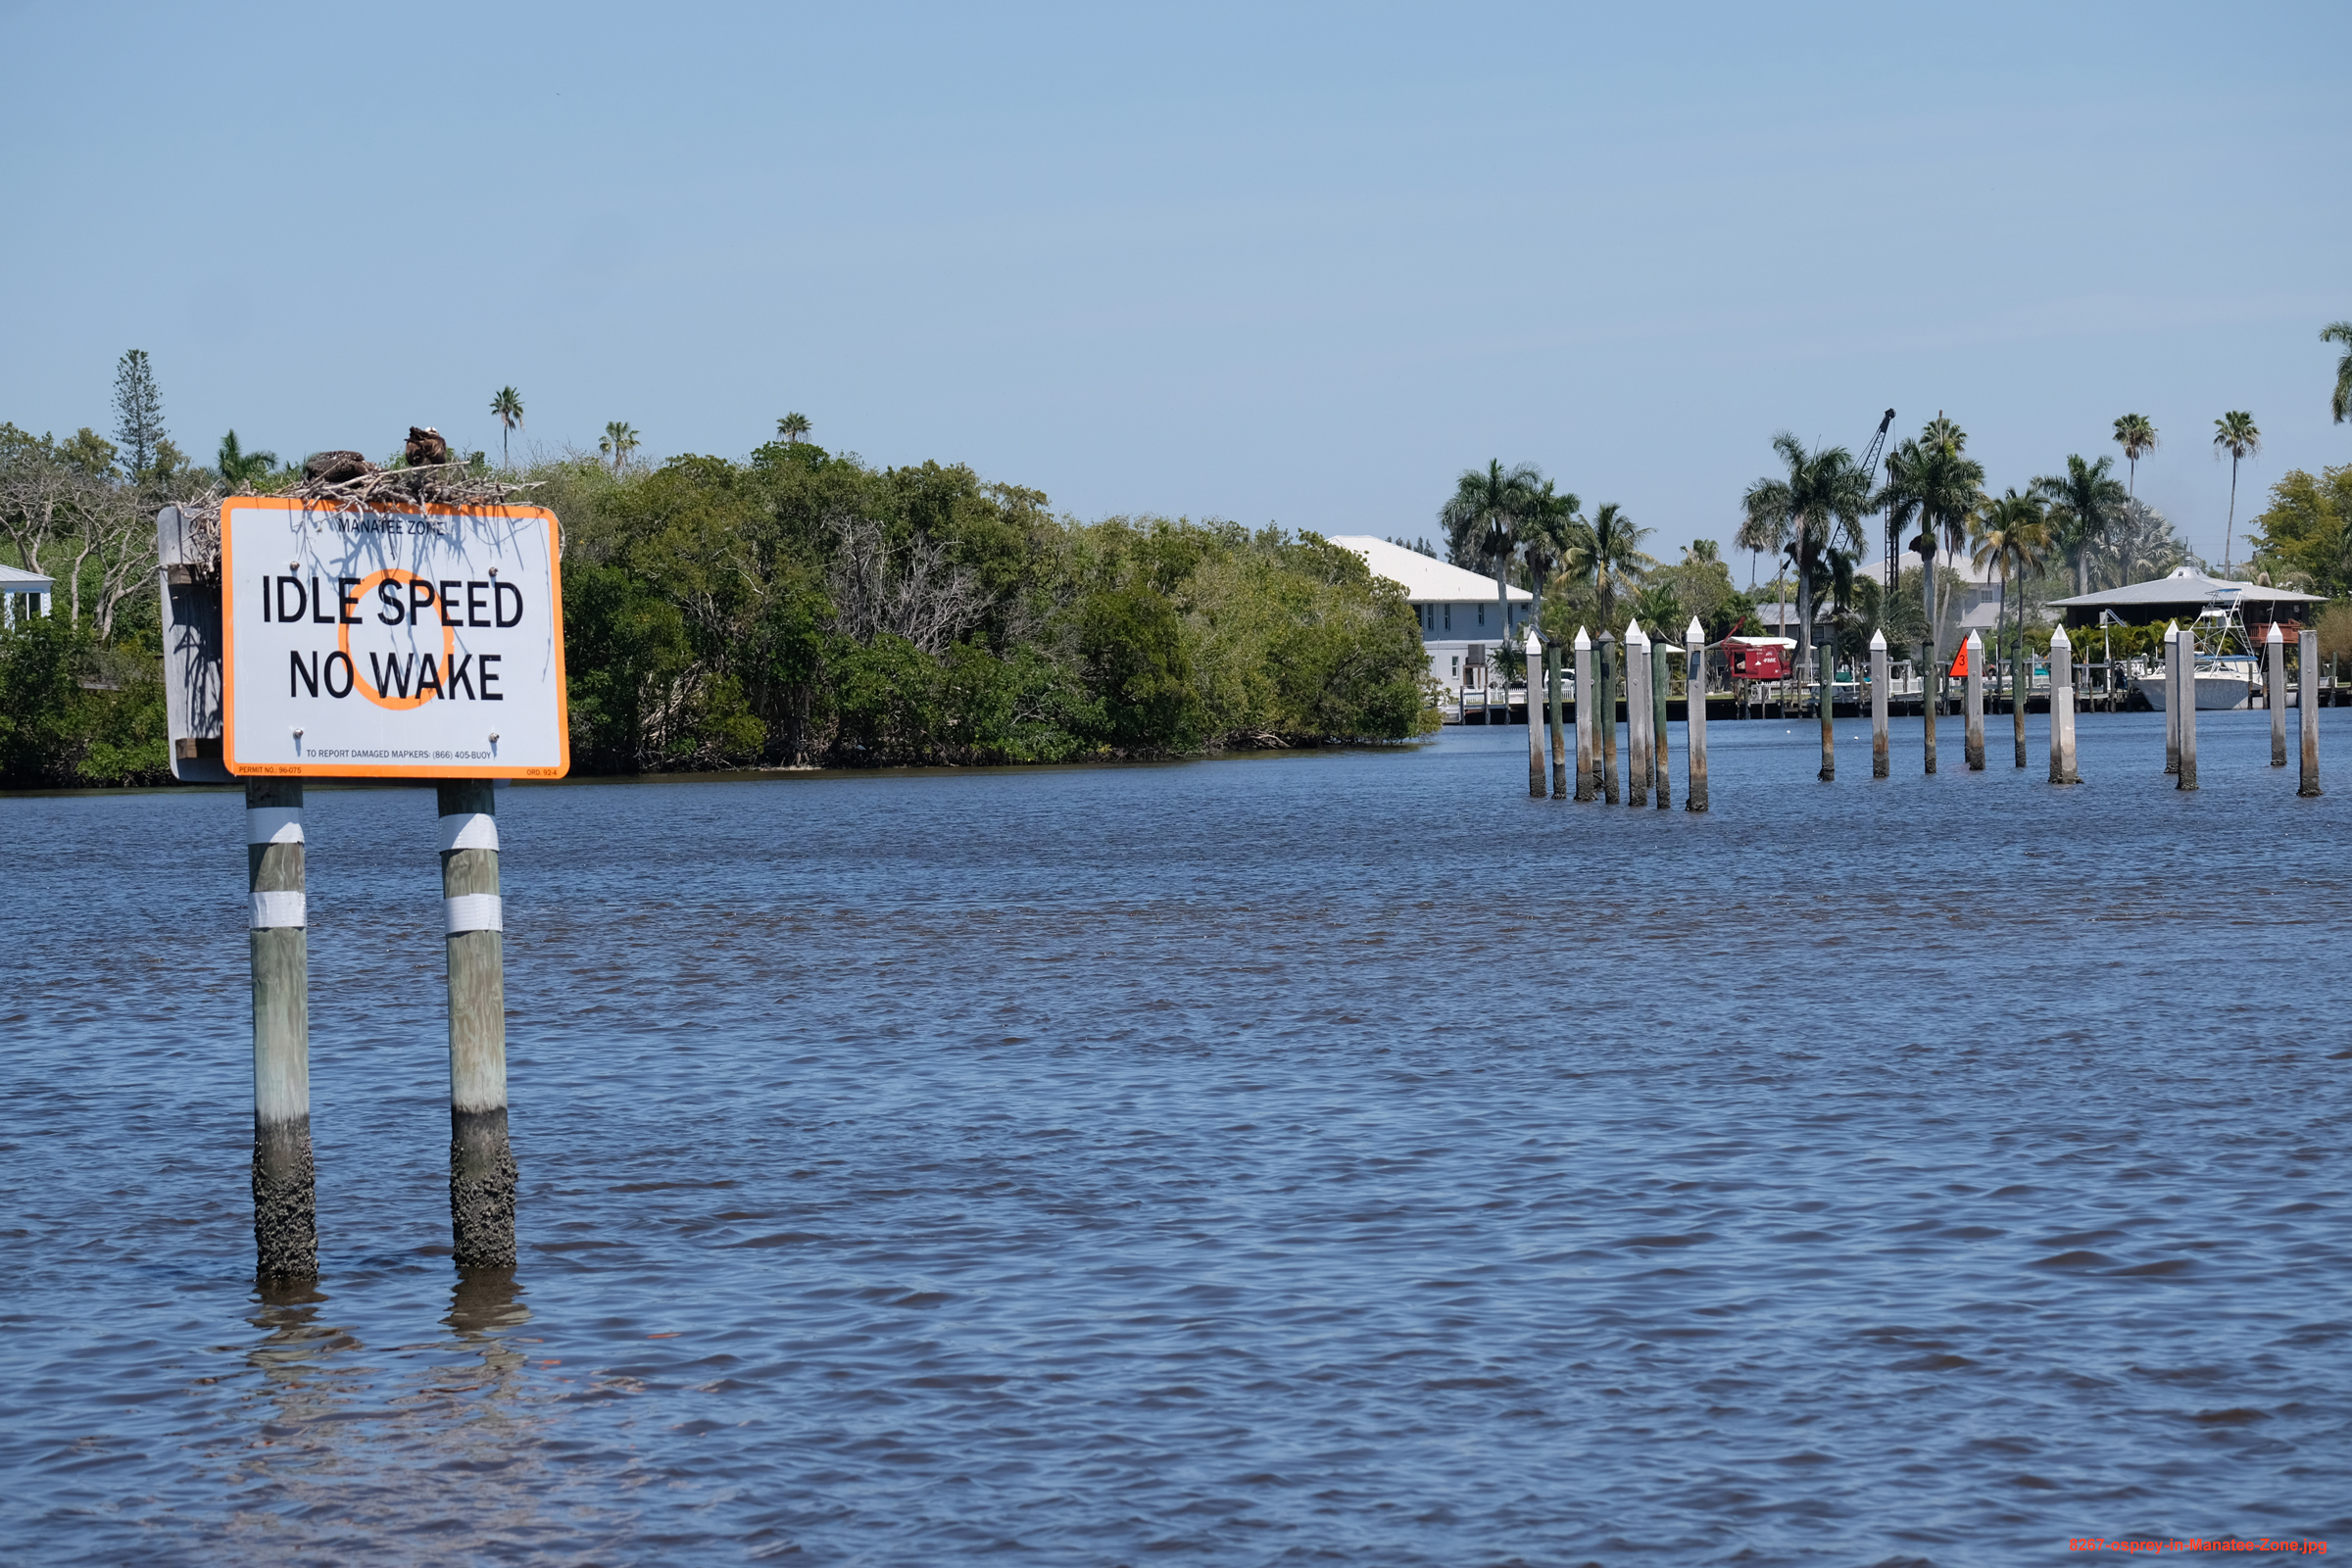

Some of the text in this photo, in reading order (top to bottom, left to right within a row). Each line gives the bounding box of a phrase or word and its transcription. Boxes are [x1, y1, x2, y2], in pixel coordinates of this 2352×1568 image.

[338, 518, 404, 534] MANATEE
[263, 575, 523, 628] IDLE SPEED
[290, 650, 503, 701] NO WAKE
[351, 750, 390, 759] DAMAGED
[432, 751, 453, 760] (866)
[455, 751, 491, 760] 405-BUOY
